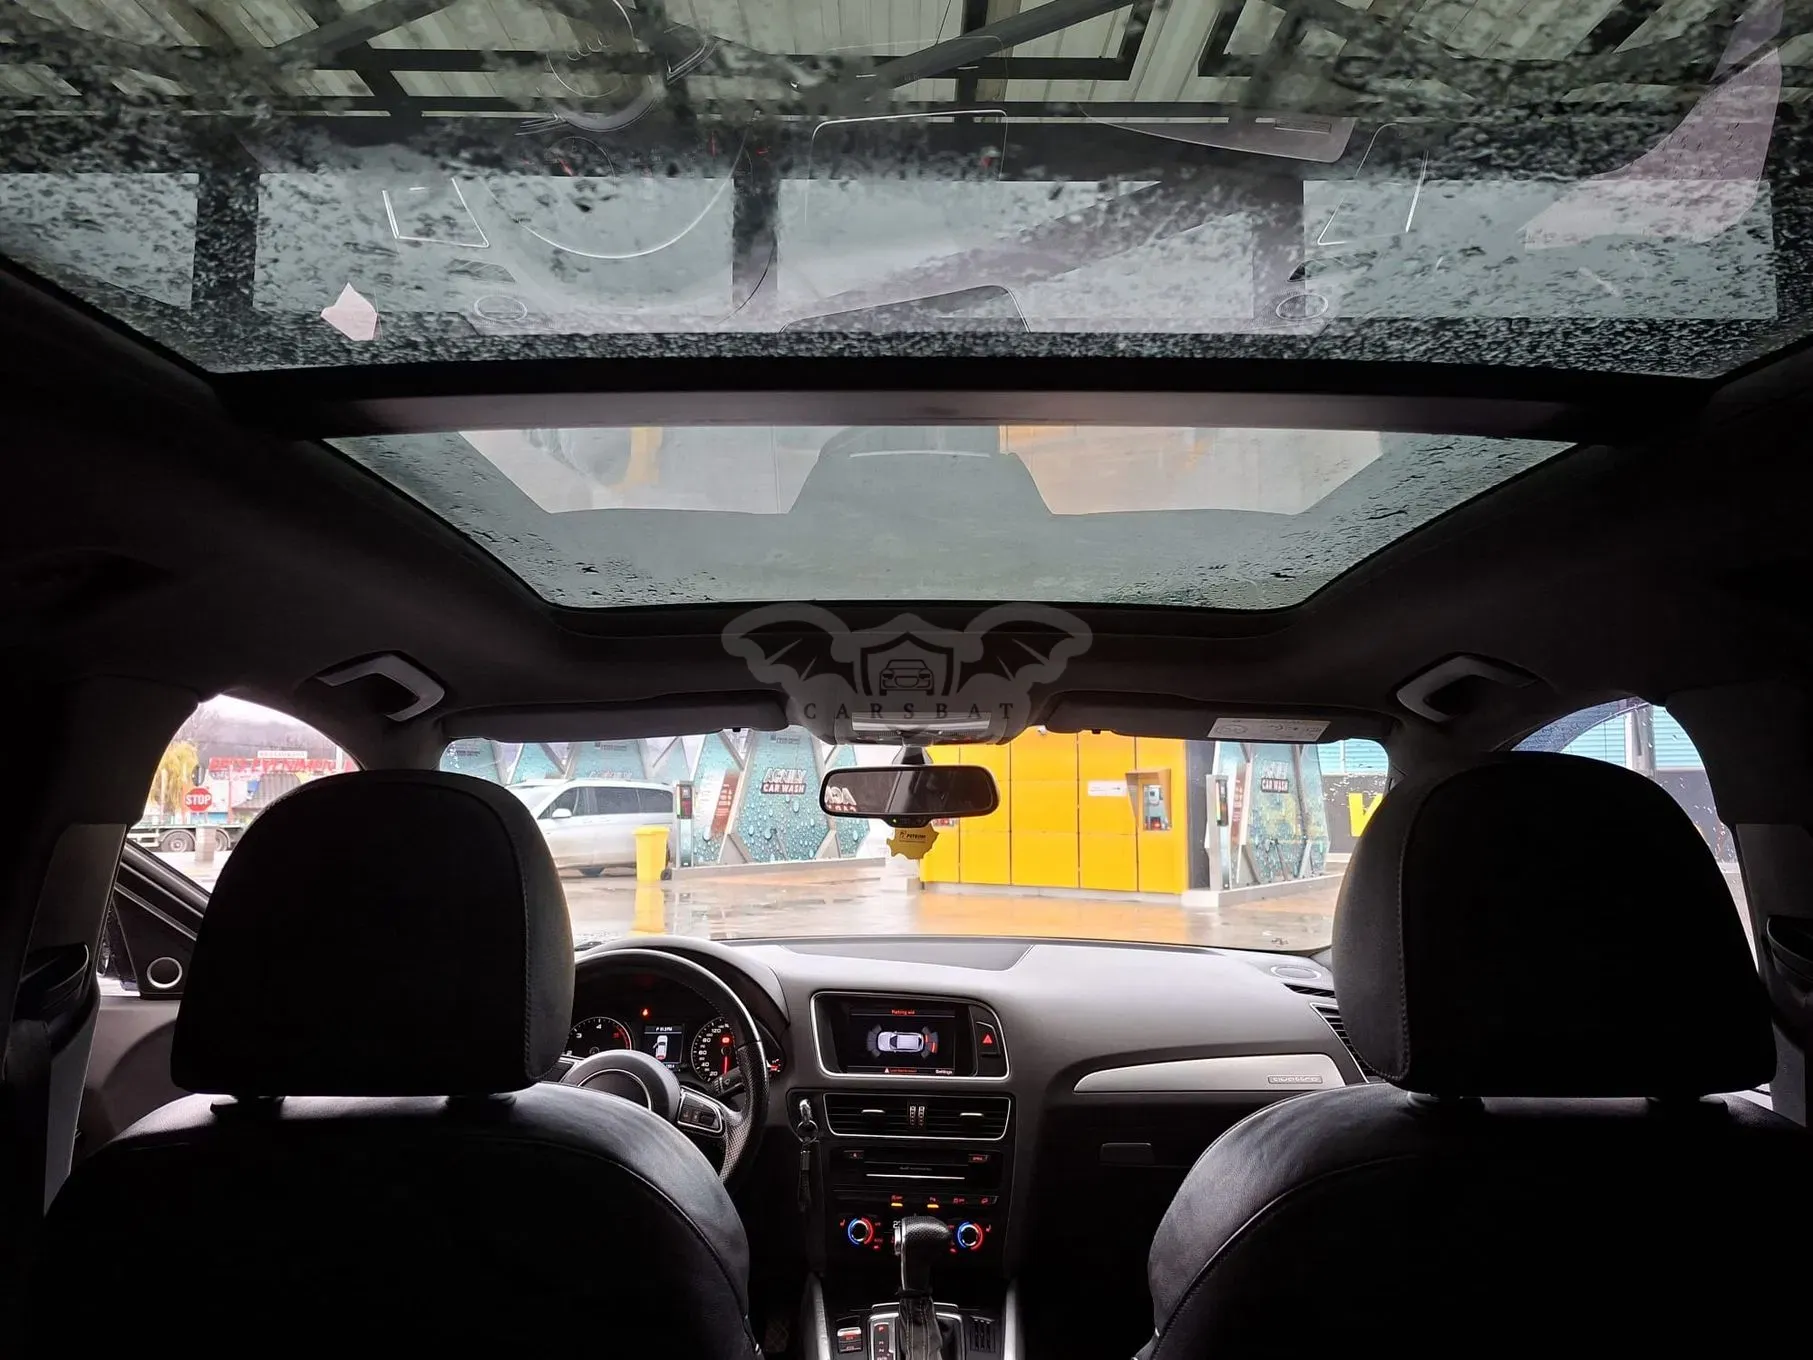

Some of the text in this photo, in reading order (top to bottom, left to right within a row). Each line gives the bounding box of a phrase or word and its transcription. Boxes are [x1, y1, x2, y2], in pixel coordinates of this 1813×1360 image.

[763, 784, 805, 793] CAR WASH
[185, 793, 211, 806] STOP
